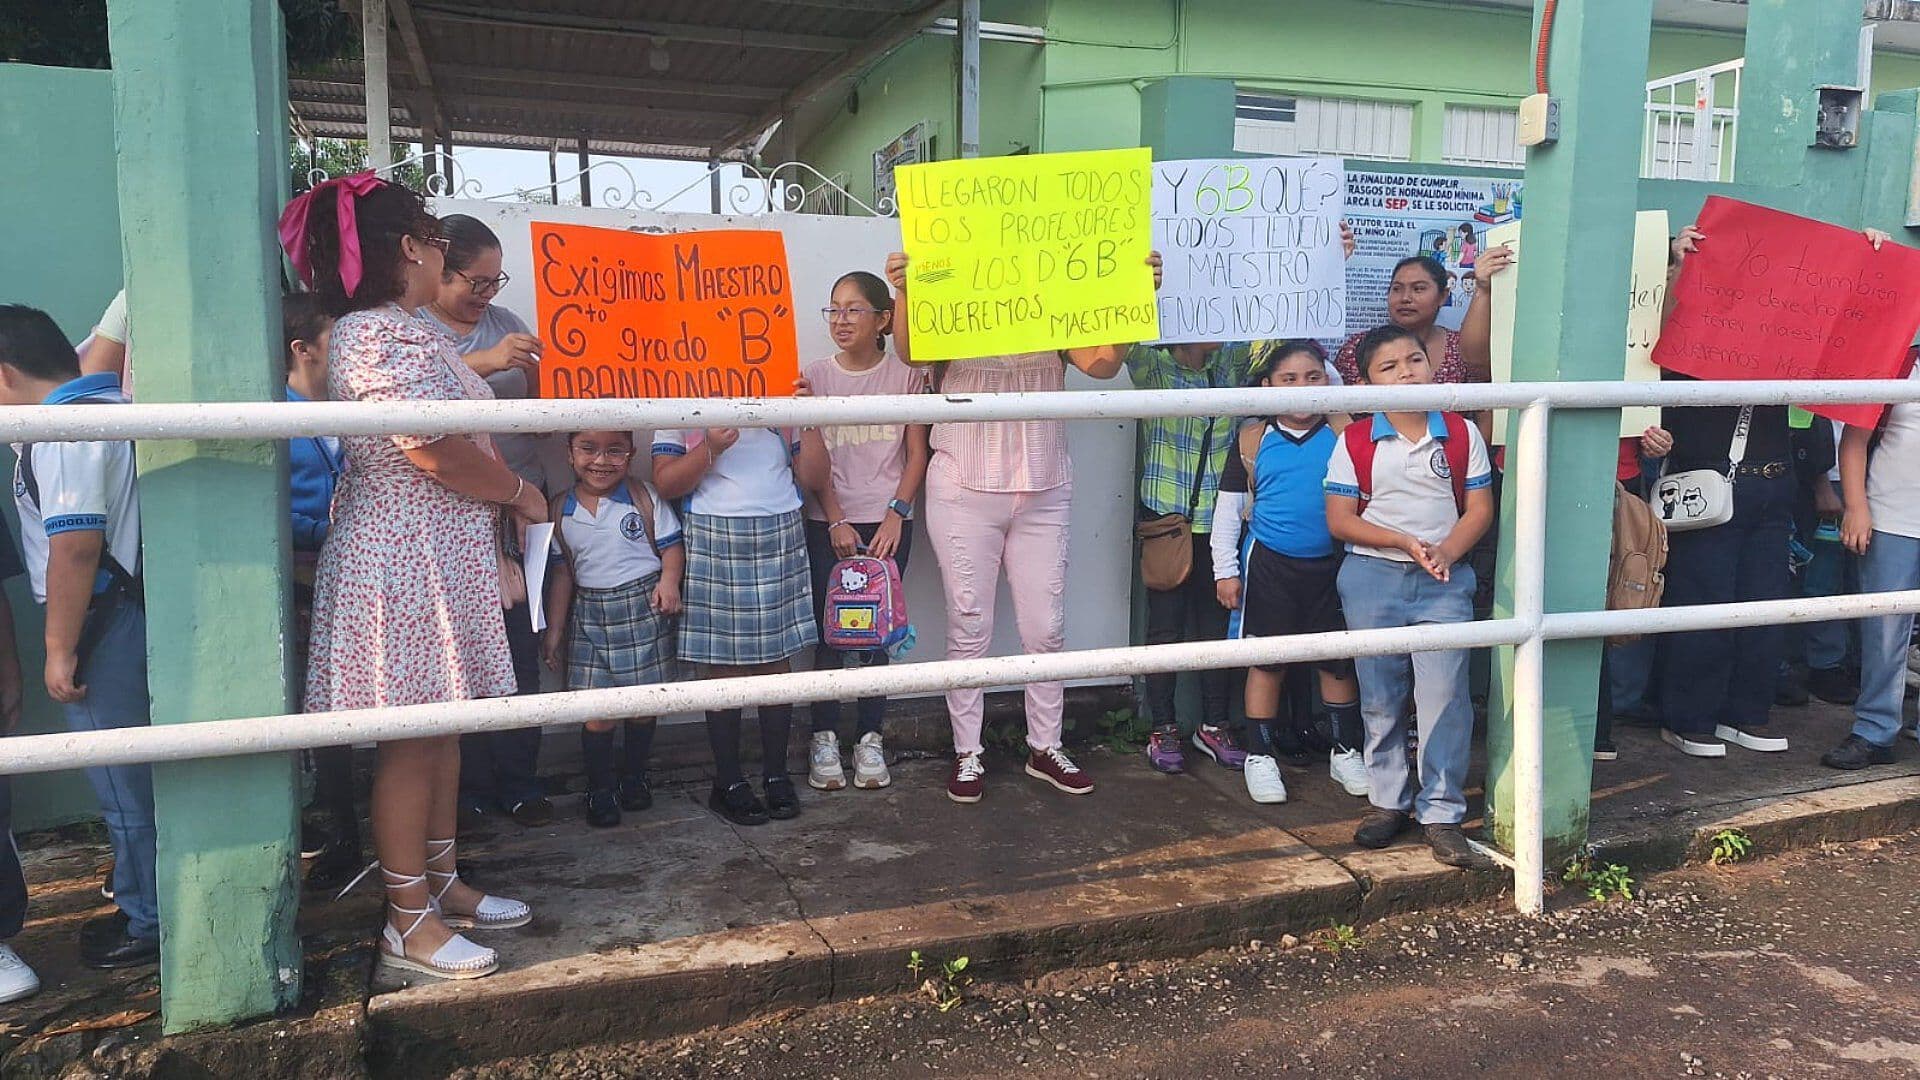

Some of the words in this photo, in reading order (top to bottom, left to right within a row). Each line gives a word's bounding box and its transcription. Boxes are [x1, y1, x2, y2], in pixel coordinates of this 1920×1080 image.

[910, 170, 1037, 209] LLEGARON
[1058, 168, 1142, 206] TODOS
[1161, 167, 1188, 215] Y
[1260, 162, 1340, 215] QUÉ?
[1347, 174, 1358, 183] LA
[1360, 175, 1405, 186] FINALIDAD
[1406, 177, 1419, 187] DE
[1420, 178, 1460, 189] CUMPLIR
[1348, 185, 1383, 195] RASGOS
[1385, 186, 1397, 196] DE
[1399, 187, 1453, 200] NORMALIDAD
[1372, 198, 1383, 208] LA
[1412, 200, 1421, 210] SE
[1425, 200, 1435, 210] LE
[914, 216, 972, 244] LOS
[1000, 205, 1136, 248] PROFESORES
[1157, 216, 1235, 249] TODOS
[1241, 216, 1331, 249] TIENEN
[1356, 218, 1382, 227] TUTOR
[1406, 221, 1416, 229] EL
[972, 255, 1021, 290] LOS
[1188, 250, 1310, 289] MAESTRO
[1232, 287, 1343, 334] NOSOTROS
[618, 321, 708, 362] grado
